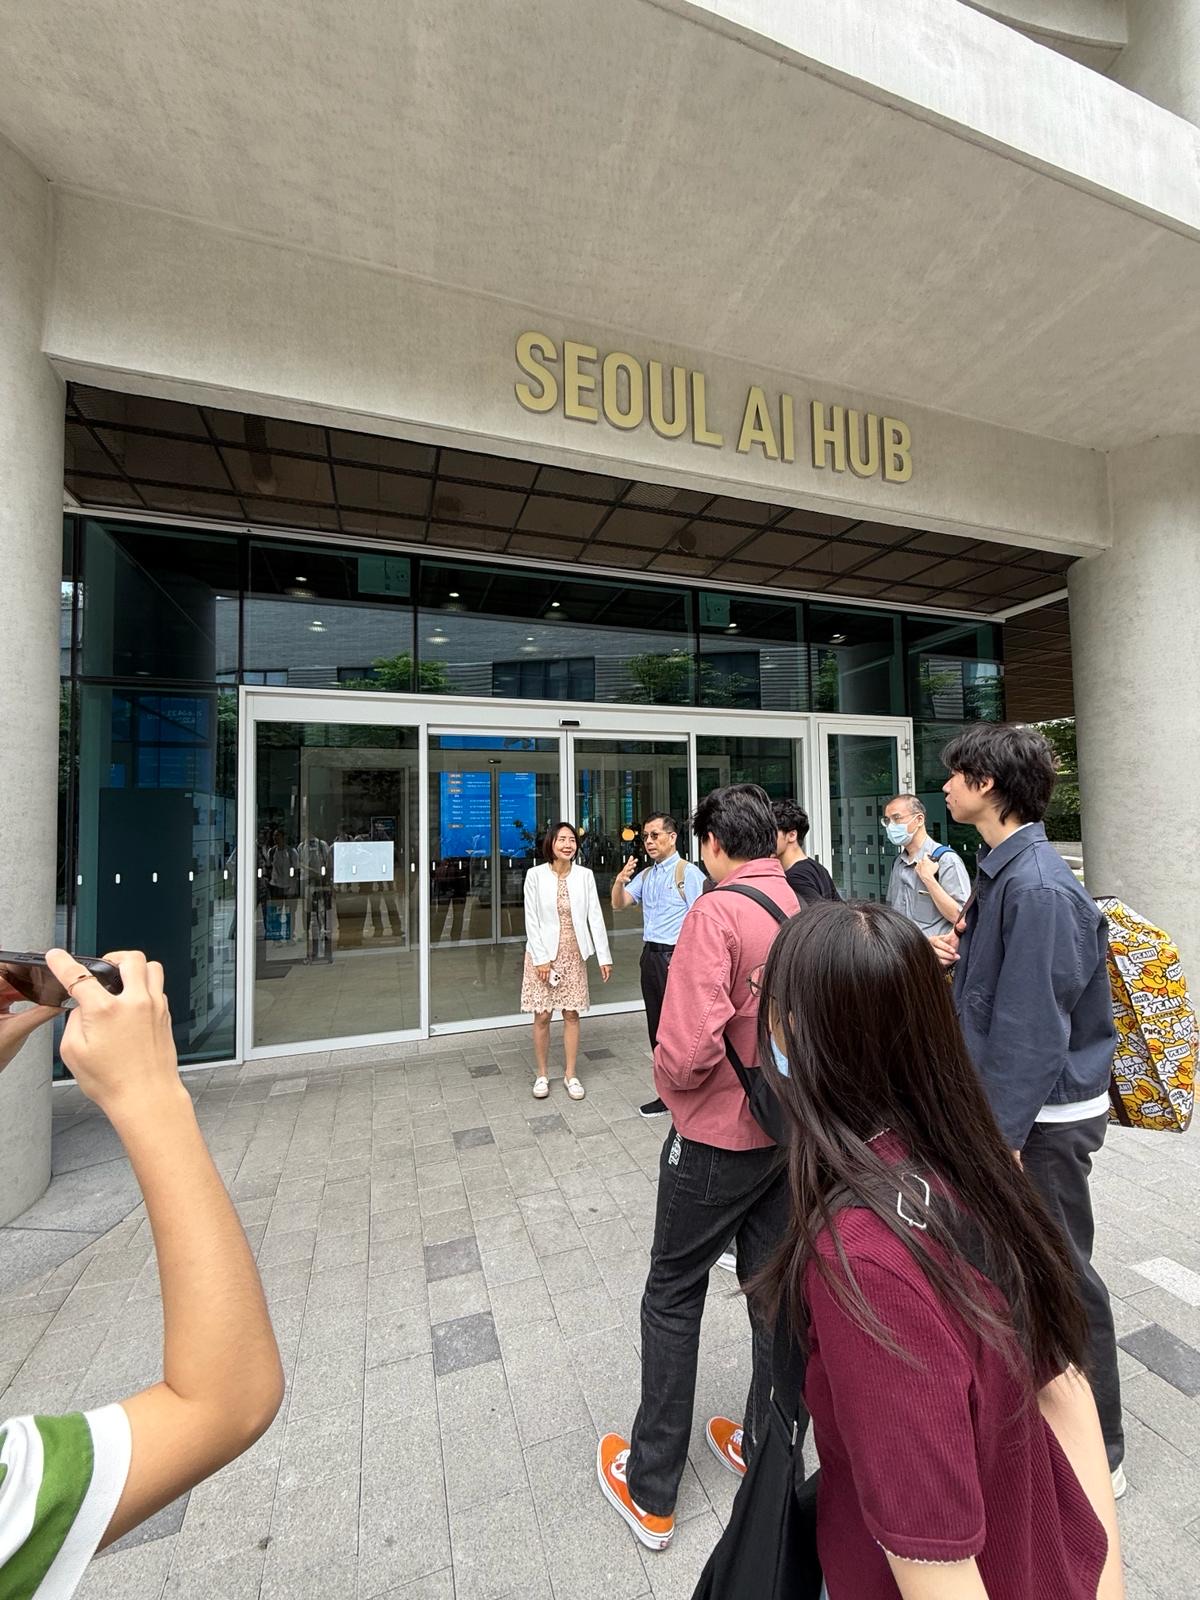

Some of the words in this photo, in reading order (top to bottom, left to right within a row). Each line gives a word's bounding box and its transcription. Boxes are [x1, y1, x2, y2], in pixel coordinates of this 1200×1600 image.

[514, 330, 724, 447] SEOUL
[736, 385, 794, 463] AI
[811, 400, 913, 484] HUB
[1149, 996, 1183, 1013] YEAH!
[1143, 1027, 1163, 1036] DUCK
[1114, 1062, 1150, 1076] PLAYFUL
[1122, 1057, 1134, 1067] BE
